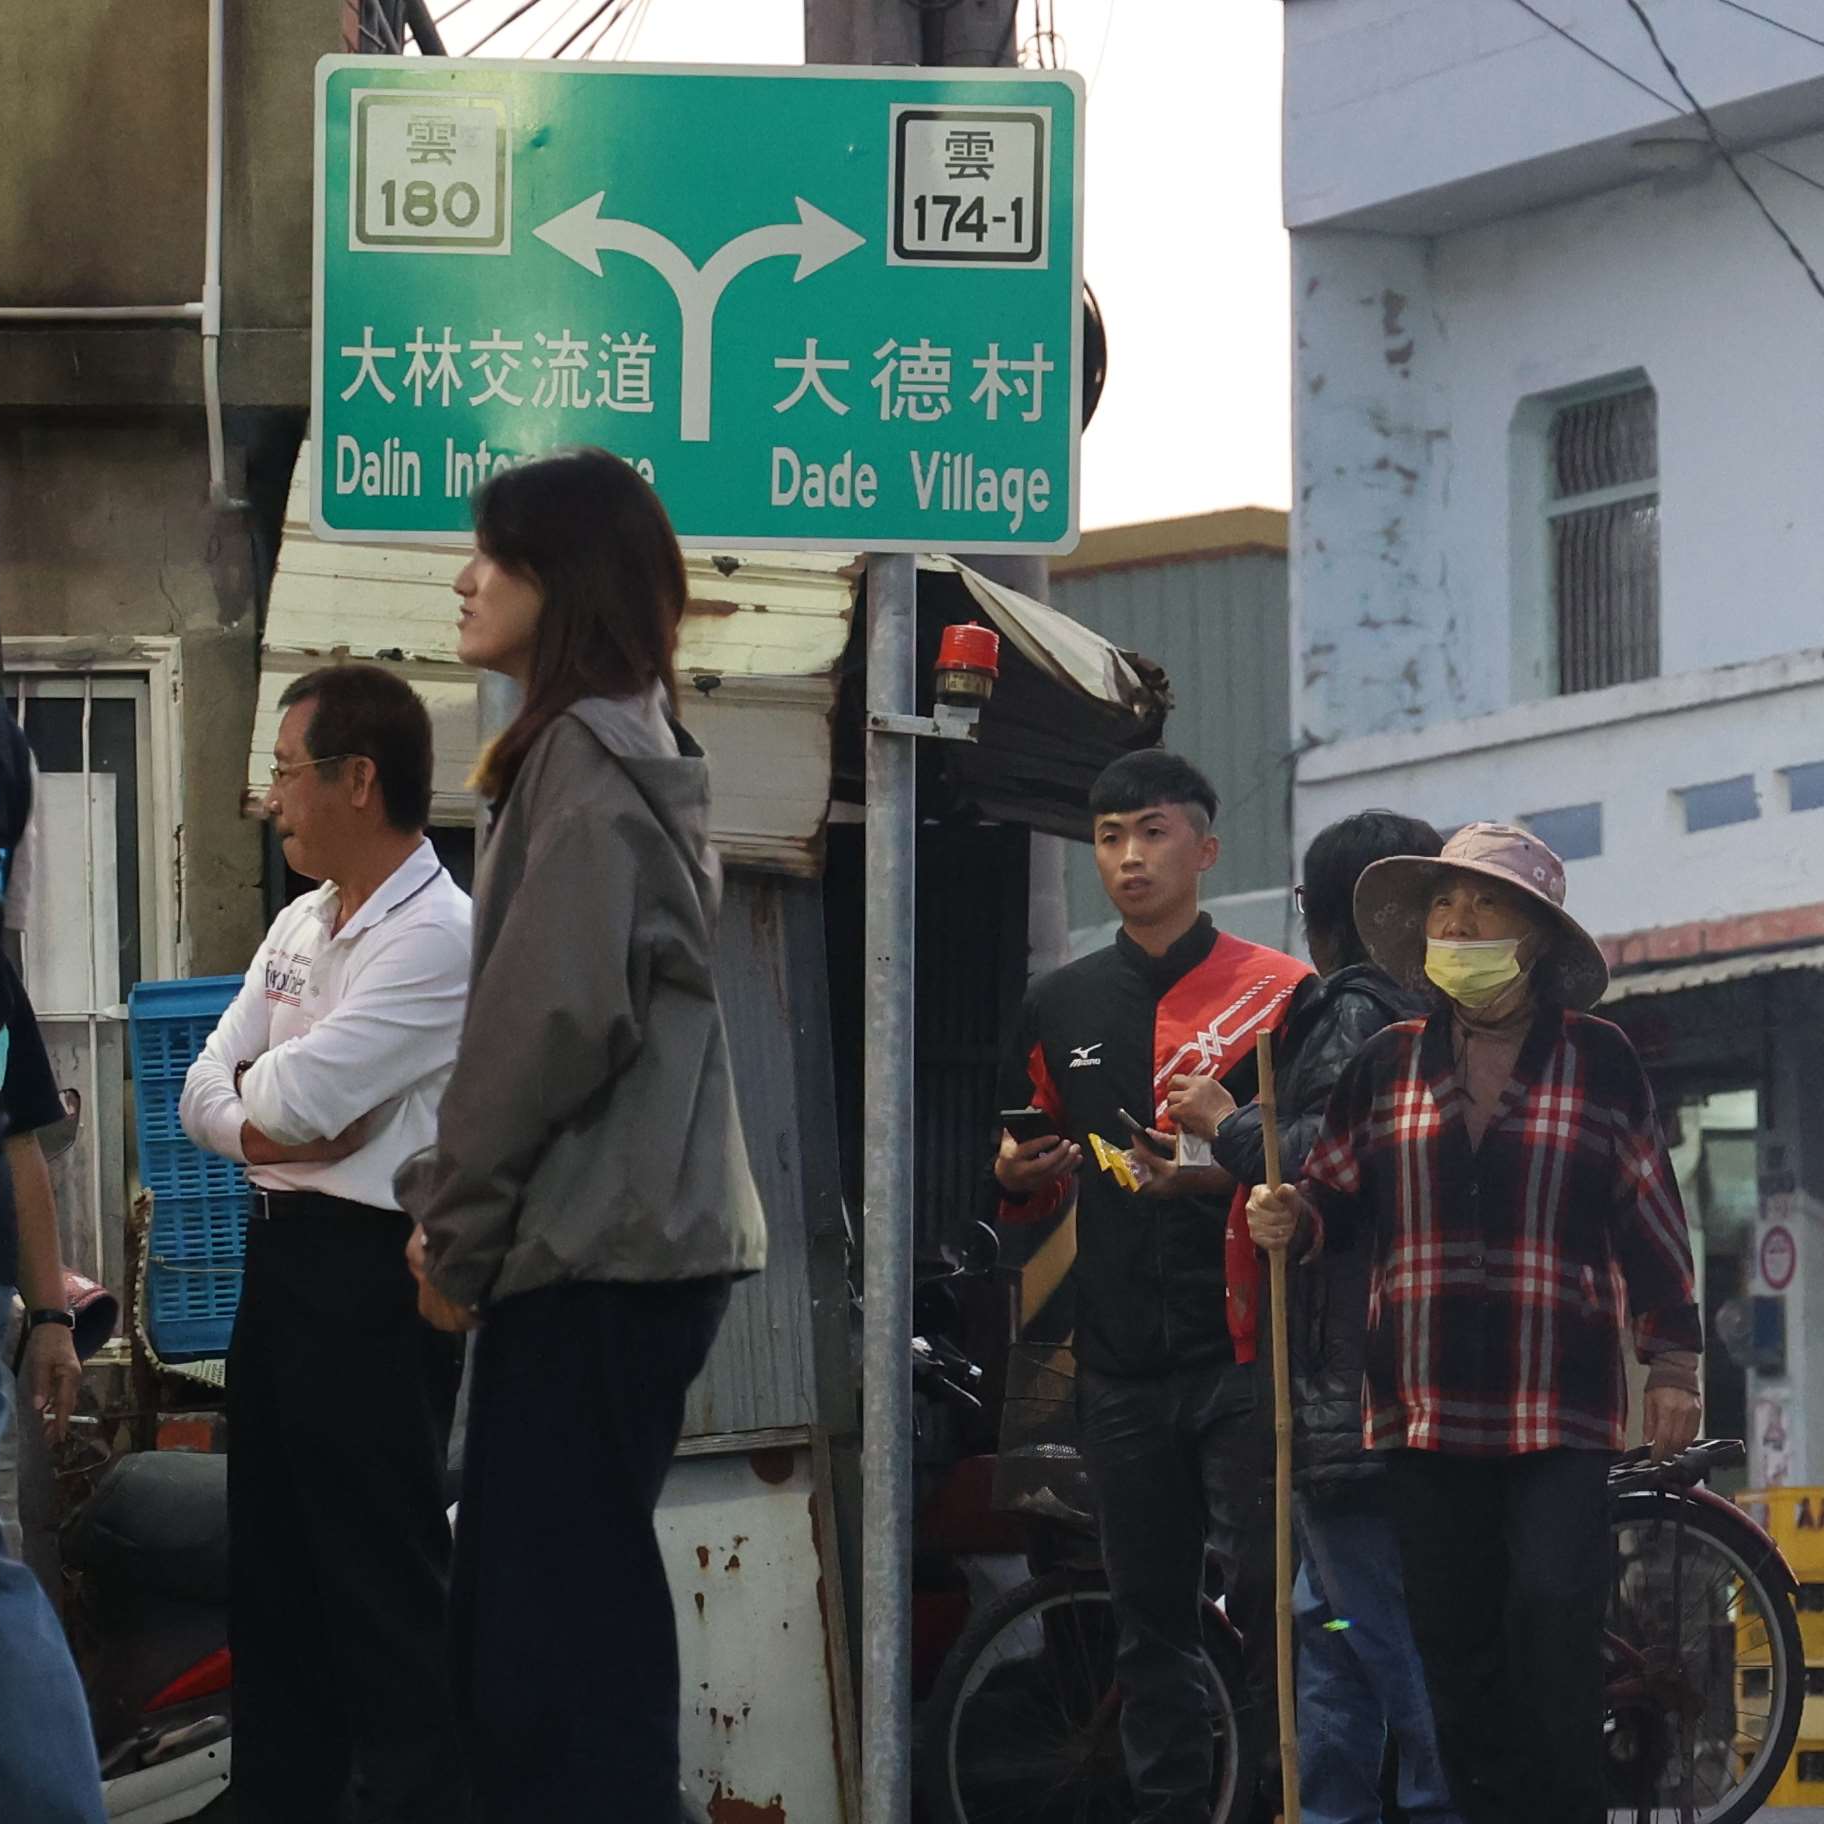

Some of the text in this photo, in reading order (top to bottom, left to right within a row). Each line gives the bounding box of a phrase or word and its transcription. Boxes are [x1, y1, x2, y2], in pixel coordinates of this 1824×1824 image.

[405, 114, 457, 167] 雲
[942, 130, 996, 182] 雲
[379, 179, 481, 228] 180
[913, 194, 1025, 243] 174-1
[339, 326, 657, 415] 大林交流道
[773, 337, 1055, 425] 大德村
[335, 434, 421, 497] Dalin
[772, 446, 1052, 533] Dade Village
